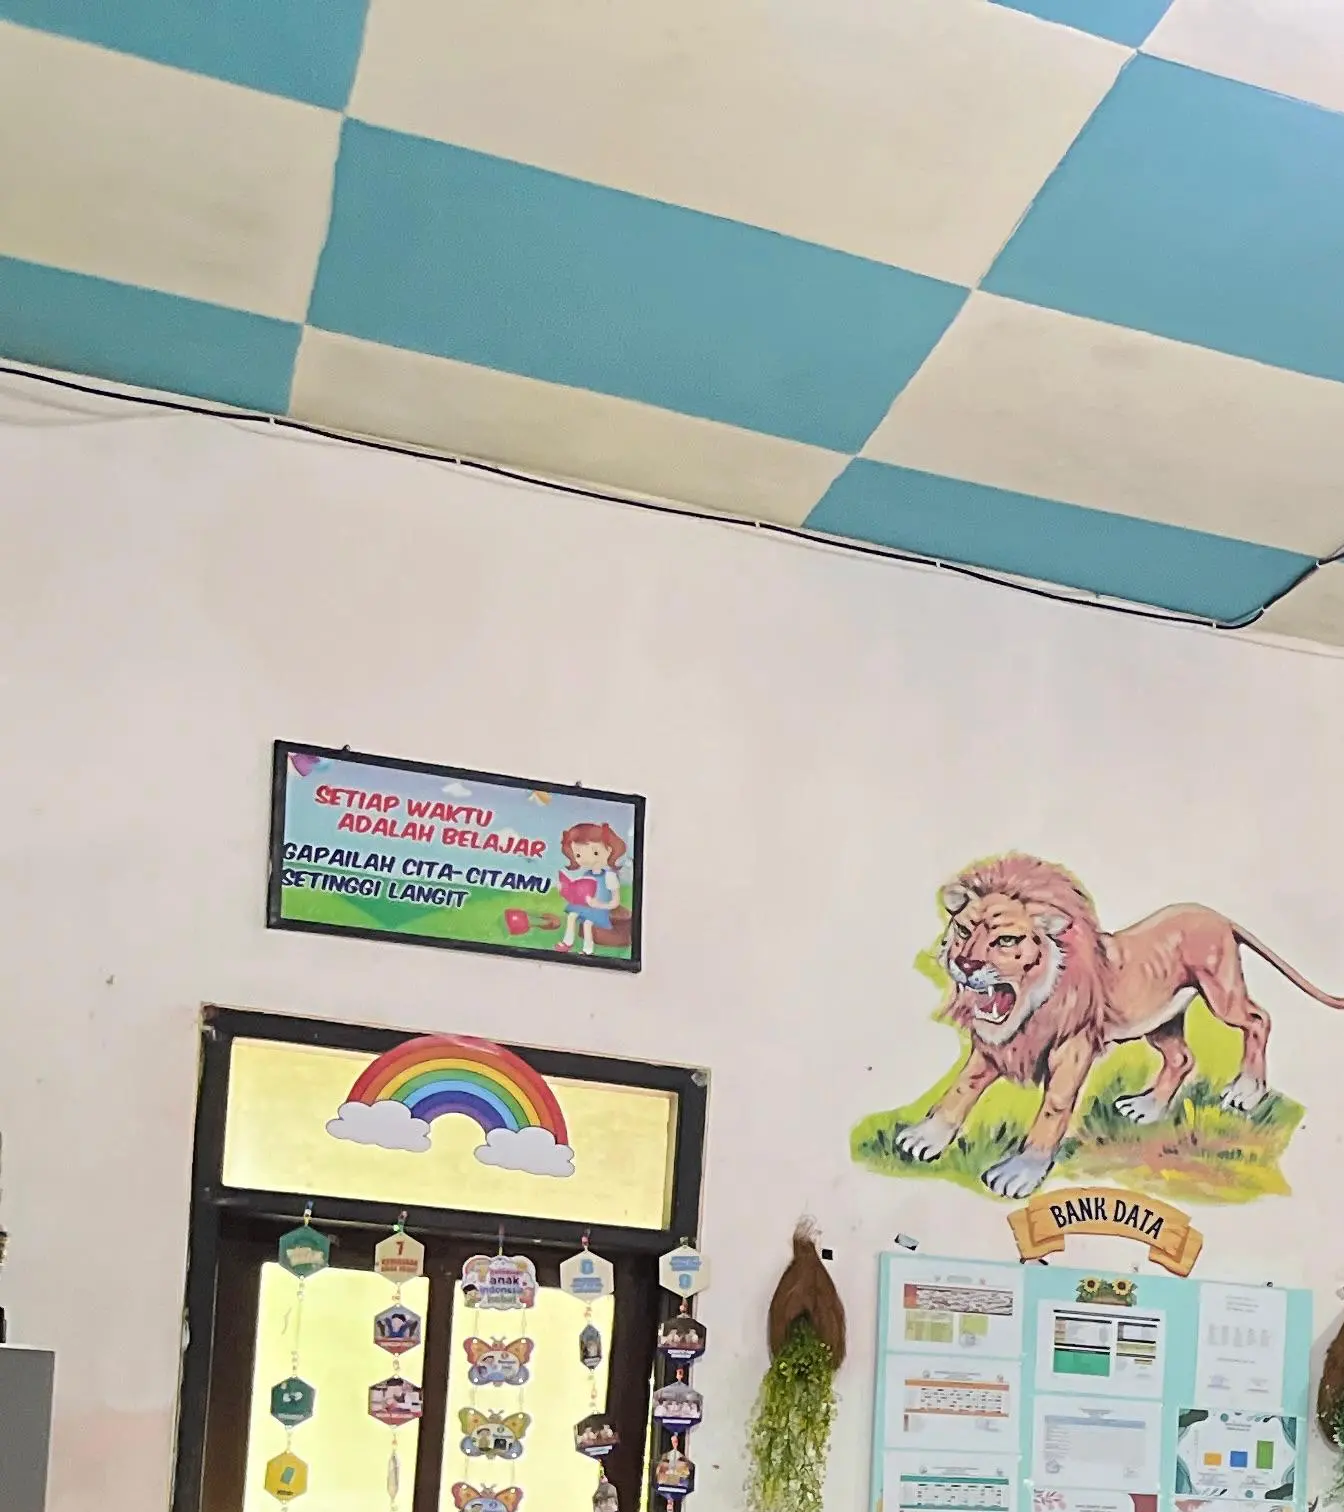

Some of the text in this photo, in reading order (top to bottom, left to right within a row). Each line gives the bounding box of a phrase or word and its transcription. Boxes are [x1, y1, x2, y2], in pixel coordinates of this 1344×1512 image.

[315, 785, 493, 827] SETIAP WAKTU
[338, 813, 546, 858] ADALAH BELAJAR
[281, 869, 469, 908] SETINGGI LANGIT
[282, 843, 551, 894] GAPAILAH CITA-CITAMU
[1050, 1198, 1164, 1239] BANK DATA
[489, 1276, 519, 1285] anak
